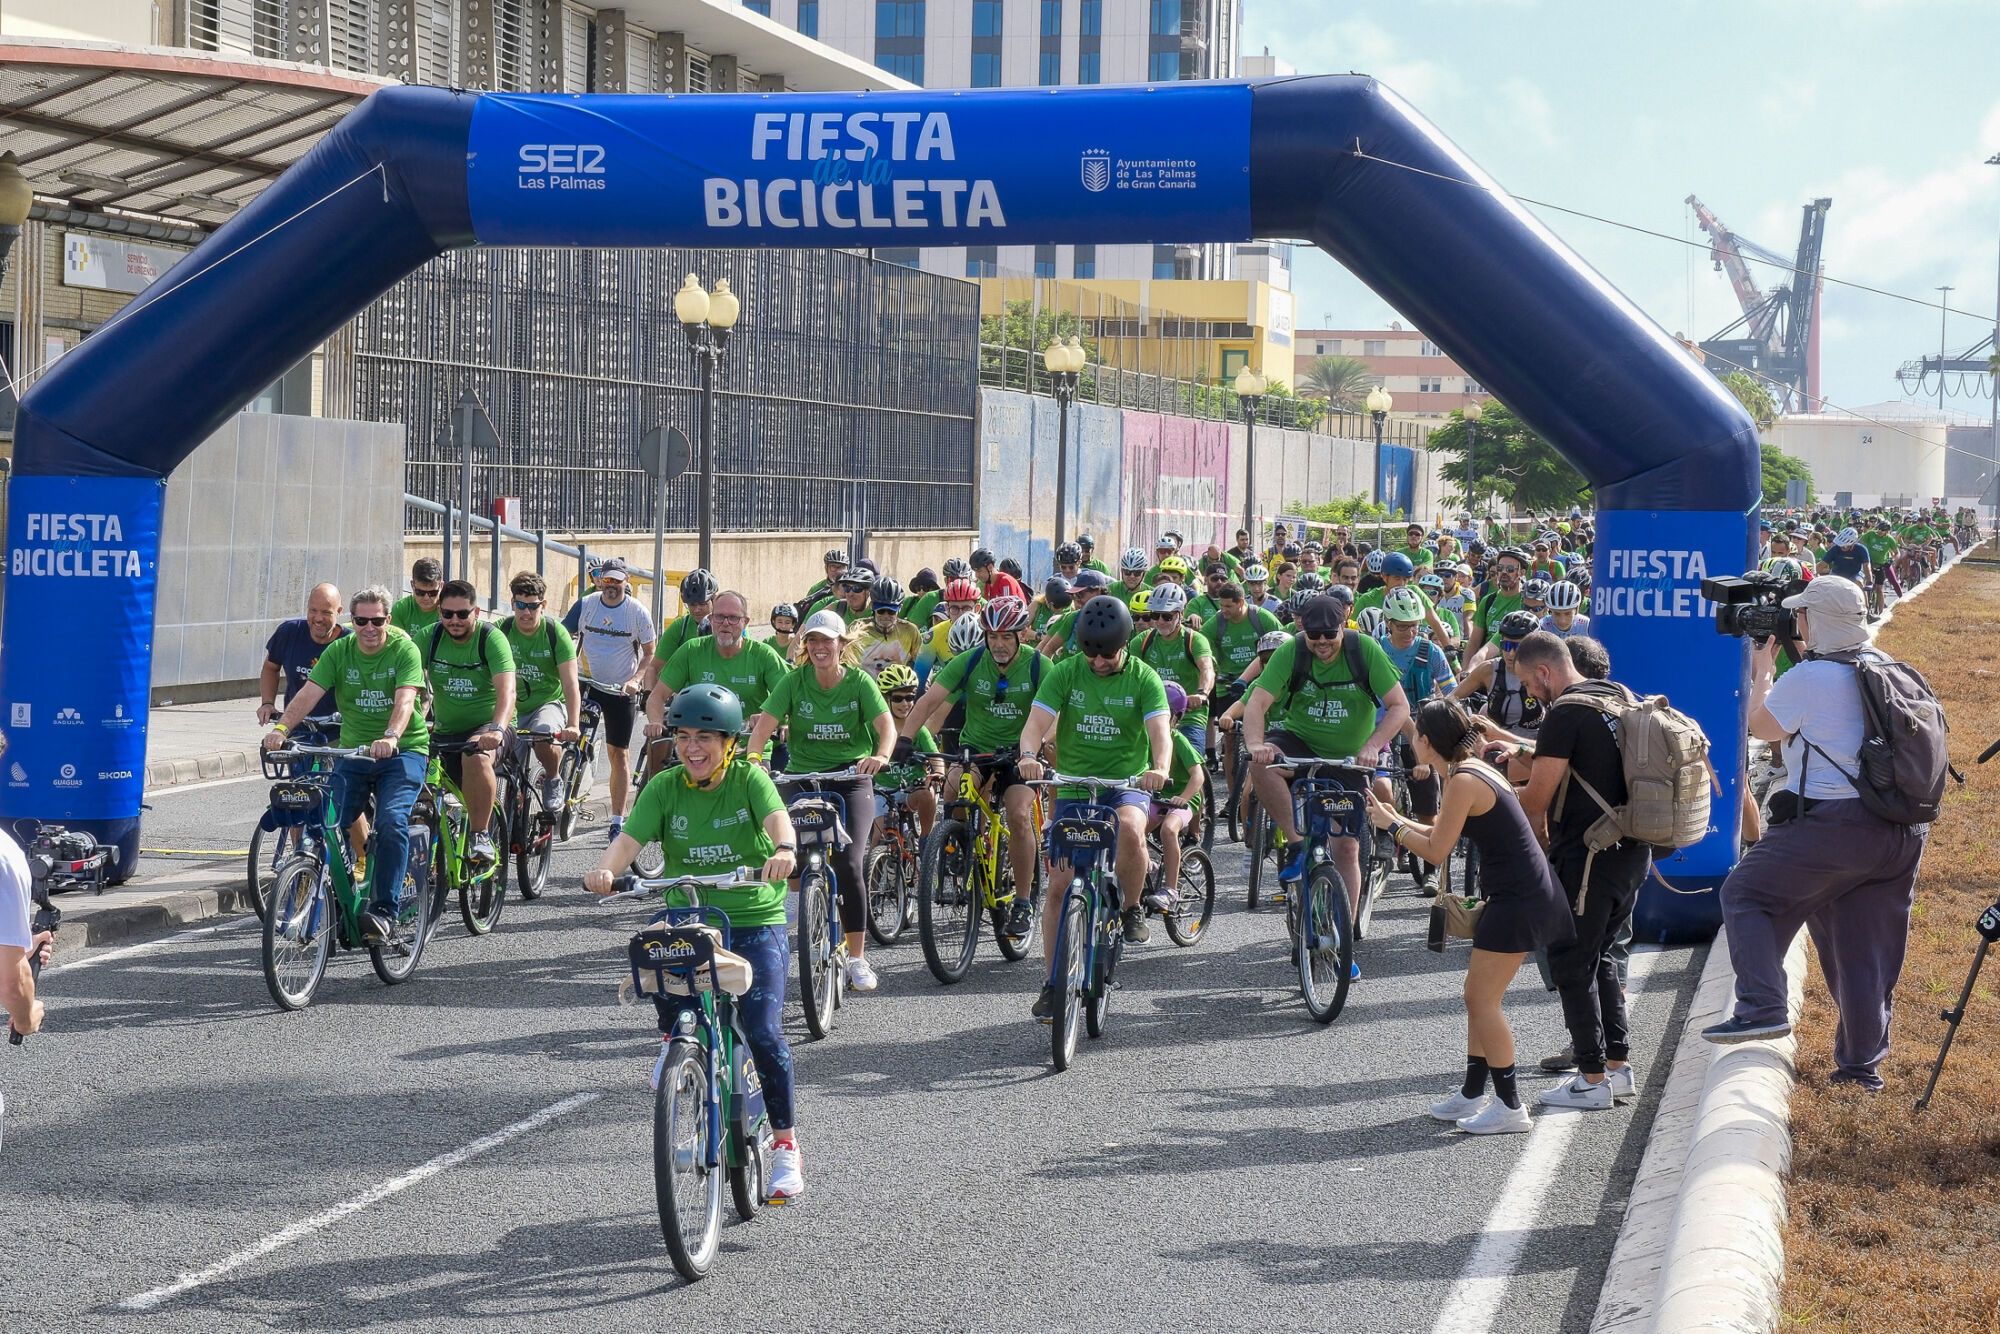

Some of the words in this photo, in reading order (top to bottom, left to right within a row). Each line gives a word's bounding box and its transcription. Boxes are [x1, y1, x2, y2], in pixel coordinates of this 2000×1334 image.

[752, 112, 955, 161] FIESTA
[519, 144, 605, 173] SER
[1116, 159, 1196, 169] Ayuntamiento
[813, 147, 850, 186] de
[861, 146, 893, 186] la
[1116, 169, 1129, 179] de
[1136, 169, 1153, 179] Las
[1159, 169, 1196, 179] Palmas
[519, 176, 545, 189] Las
[550, 175, 605, 190] Palmas
[1116, 180, 1129, 189] de
[1131, 180, 1156, 189] Gran
[1158, 179, 1196, 189] Canaria
[703, 177, 1006, 228] BICICLETA
[1862, 436, 1872, 444] 24
[27, 513, 122, 541] FIESTA
[12, 548, 141, 577] BICICLETA
[1609, 549, 1707, 579] FIESTA
[702, 672, 715, 681] 30
[977, 679, 991, 690] 30
[1071, 689, 1085, 702] 30
[800, 701, 814, 714] 30
[1083, 714, 1115, 726] FIESTA
[813, 724, 844, 732] FIESTA
[1076, 723, 1121, 735] BICICLETA
[688, 844, 732, 858] FIESTA
